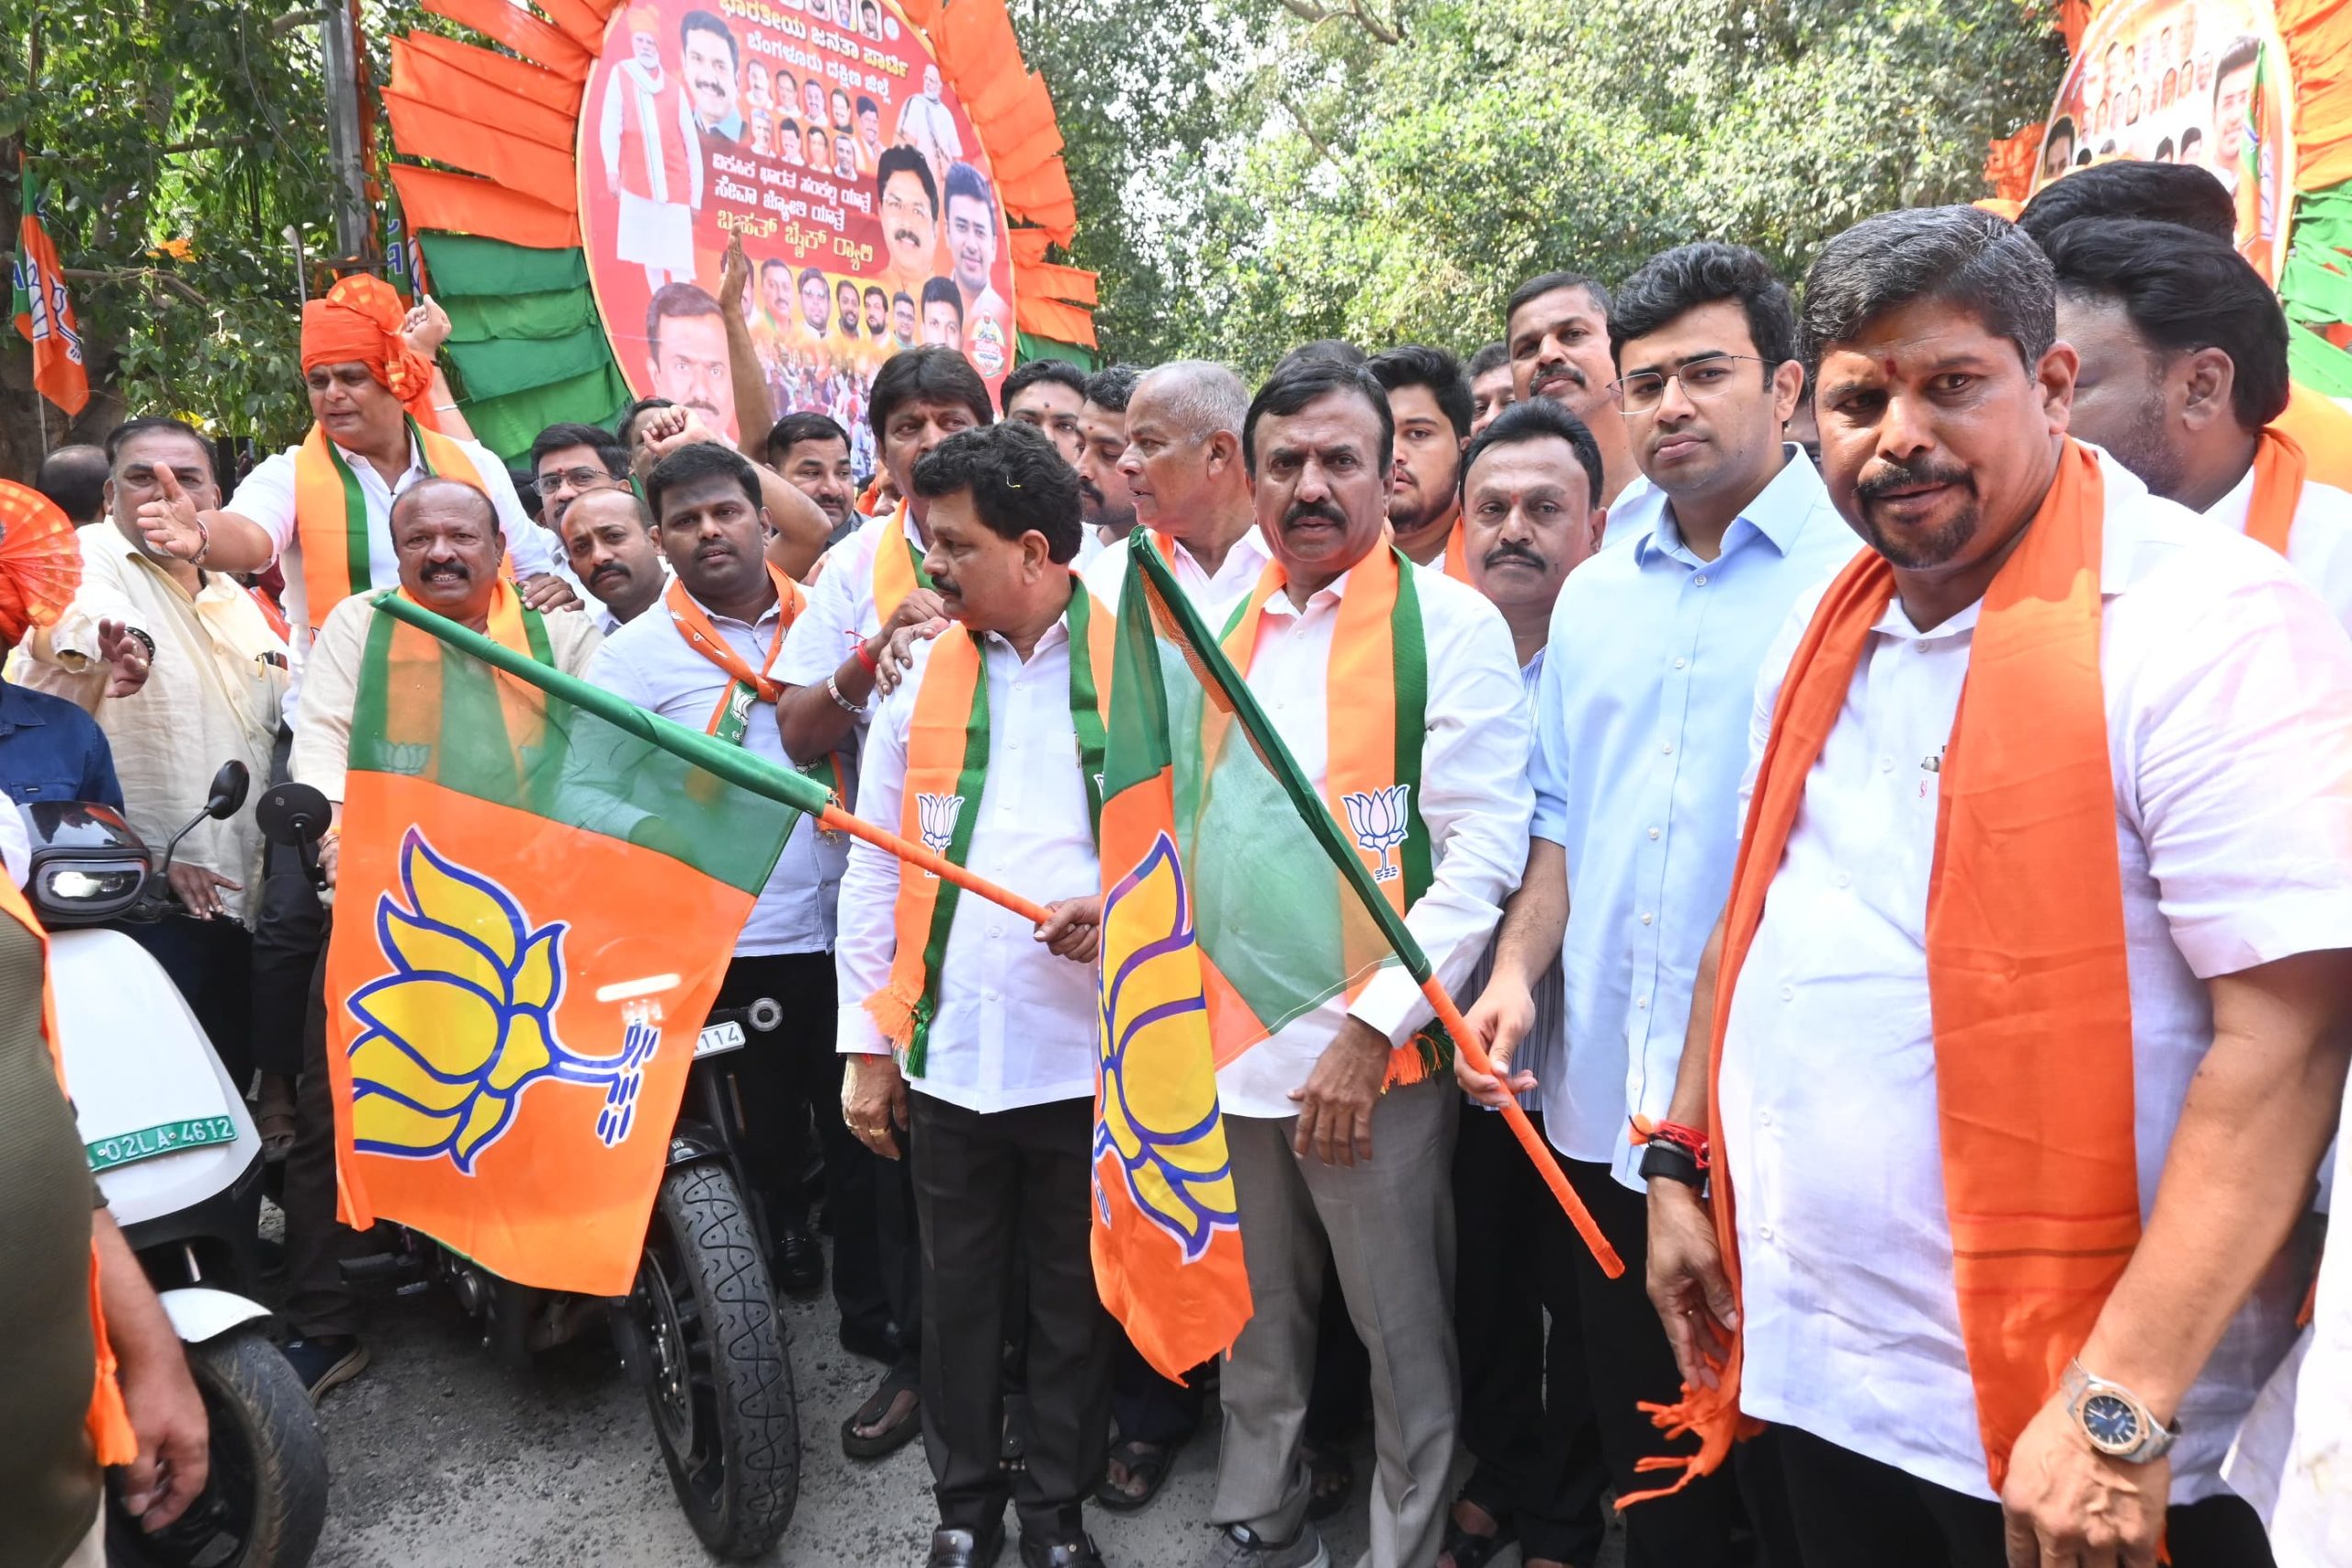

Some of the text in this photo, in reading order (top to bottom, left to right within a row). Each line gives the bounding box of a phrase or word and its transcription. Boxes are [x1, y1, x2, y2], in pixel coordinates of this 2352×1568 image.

[719, 0, 808, 39] ಭಾರತೀಯ
[810, 25, 859, 60] ಜನತಾ
[746, 29, 822, 73] ಬೆಂಗಳೂರು
[826, 60, 862, 90] ದಕ್ಷಿಣ
[714, 175, 757, 205] ಸೇವಾ
[785, 220, 827, 259] ಬೈಕ್
[695, 1026, 740, 1051] 114
[182, 1119, 232, 1143] 4612
